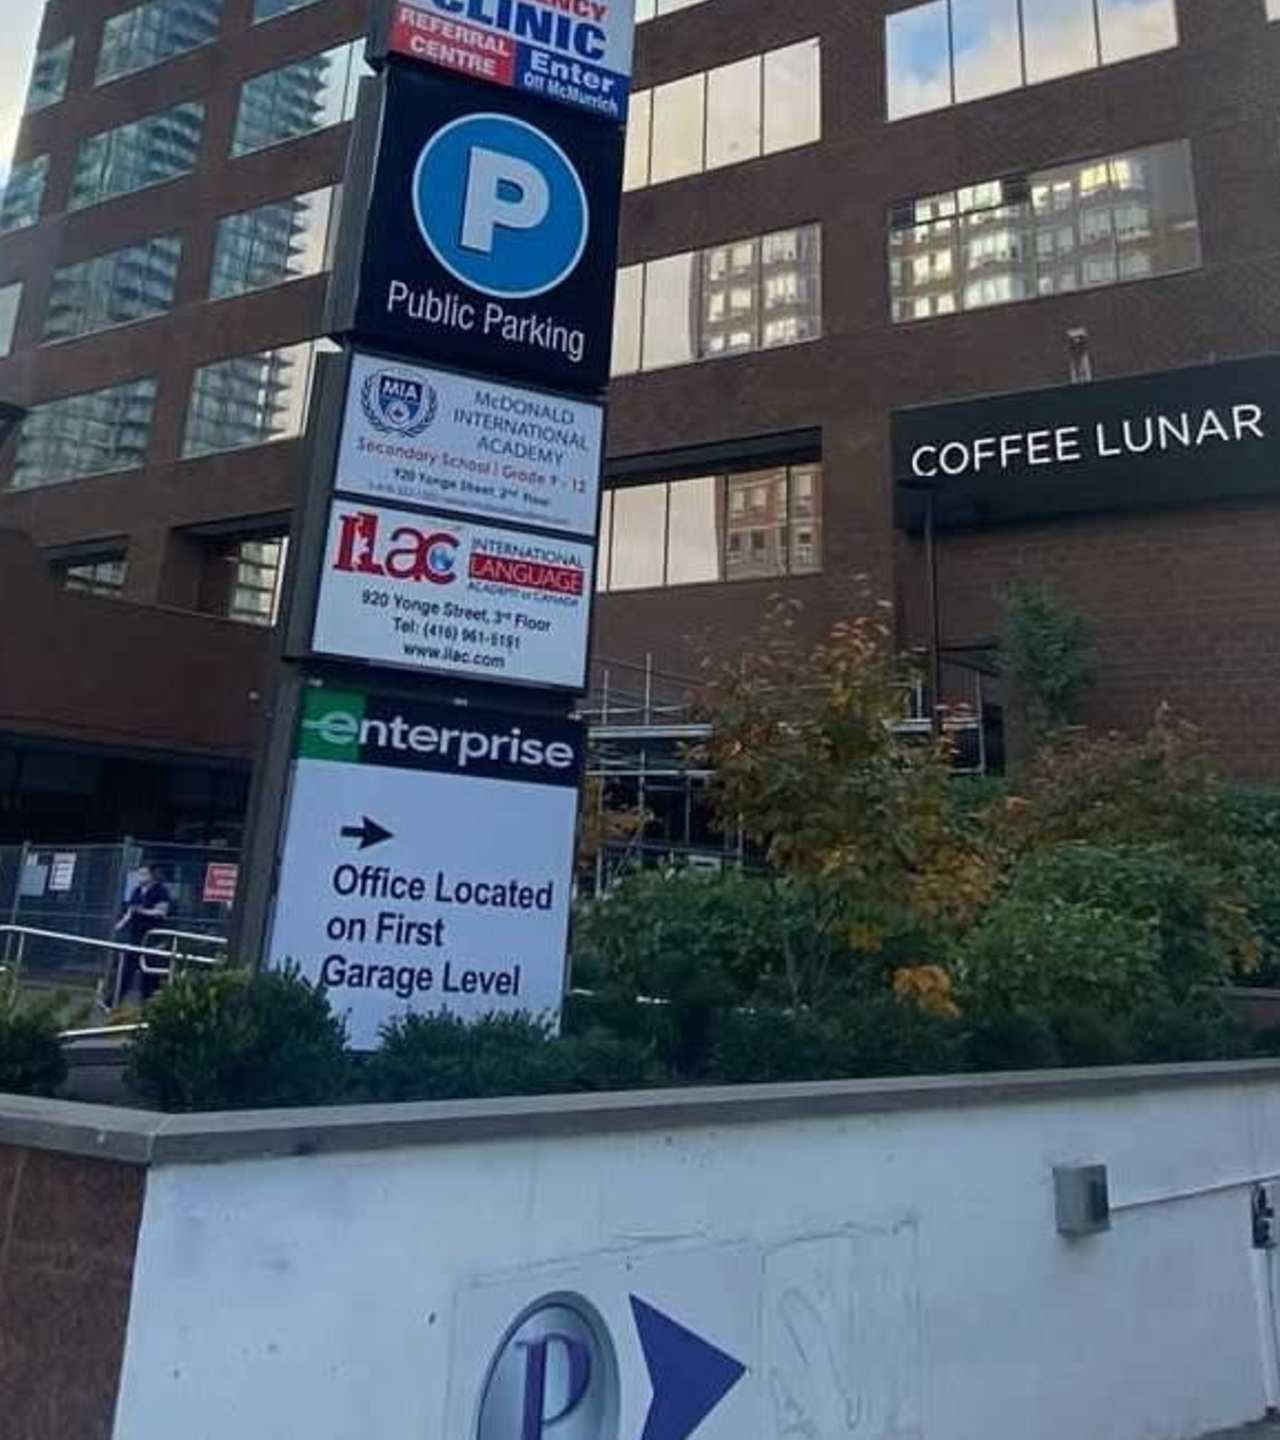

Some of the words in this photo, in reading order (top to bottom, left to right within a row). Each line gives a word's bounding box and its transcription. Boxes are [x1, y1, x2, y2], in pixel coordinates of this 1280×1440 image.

[399, 7, 510, 58] REFERRAL
[410, 36, 498, 76] CENTRE
[529, 50, 615, 94] Enter
[460, 145, 550, 253] P
[387, 281, 476, 330] Public
[484, 303, 586, 363] Parking
[382, 379, 418, 401] MIA
[474, 390, 575, 426] McDONALD
[453, 409, 590, 451] INTERNATIONAL
[477, 435, 564, 467] ACADEMY
[911, 426, 1081, 478] COFFEE
[1094, 403, 1266, 458] LUNAR
[357, 436, 439, 468] Secondary
[442, 453, 492, 476] School
[502, 464, 546, 487] Grade
[572, 478, 587, 494] 12
[471, 537, 584, 569] INTERNATIONAL
[471, 557, 582, 592] LANGUAGE
[361, 589, 388, 608] 920
[393, 591, 441, 618] Yonge
[443, 602, 491, 624] Street,
[514, 612, 551, 633] Floor
[393, 617, 421, 635] Tel:
[422, 620, 459, 642] (416)
[403, 643, 506, 669] www.ilac.com
[302, 710, 574, 768] enterprise
[332, 864, 426, 901] Office
[436, 872, 554, 910] Located
[326, 915, 366, 942] on
[375, 912, 445, 947] First
[322, 955, 433, 999] Garage
[442, 962, 520, 997] Level
